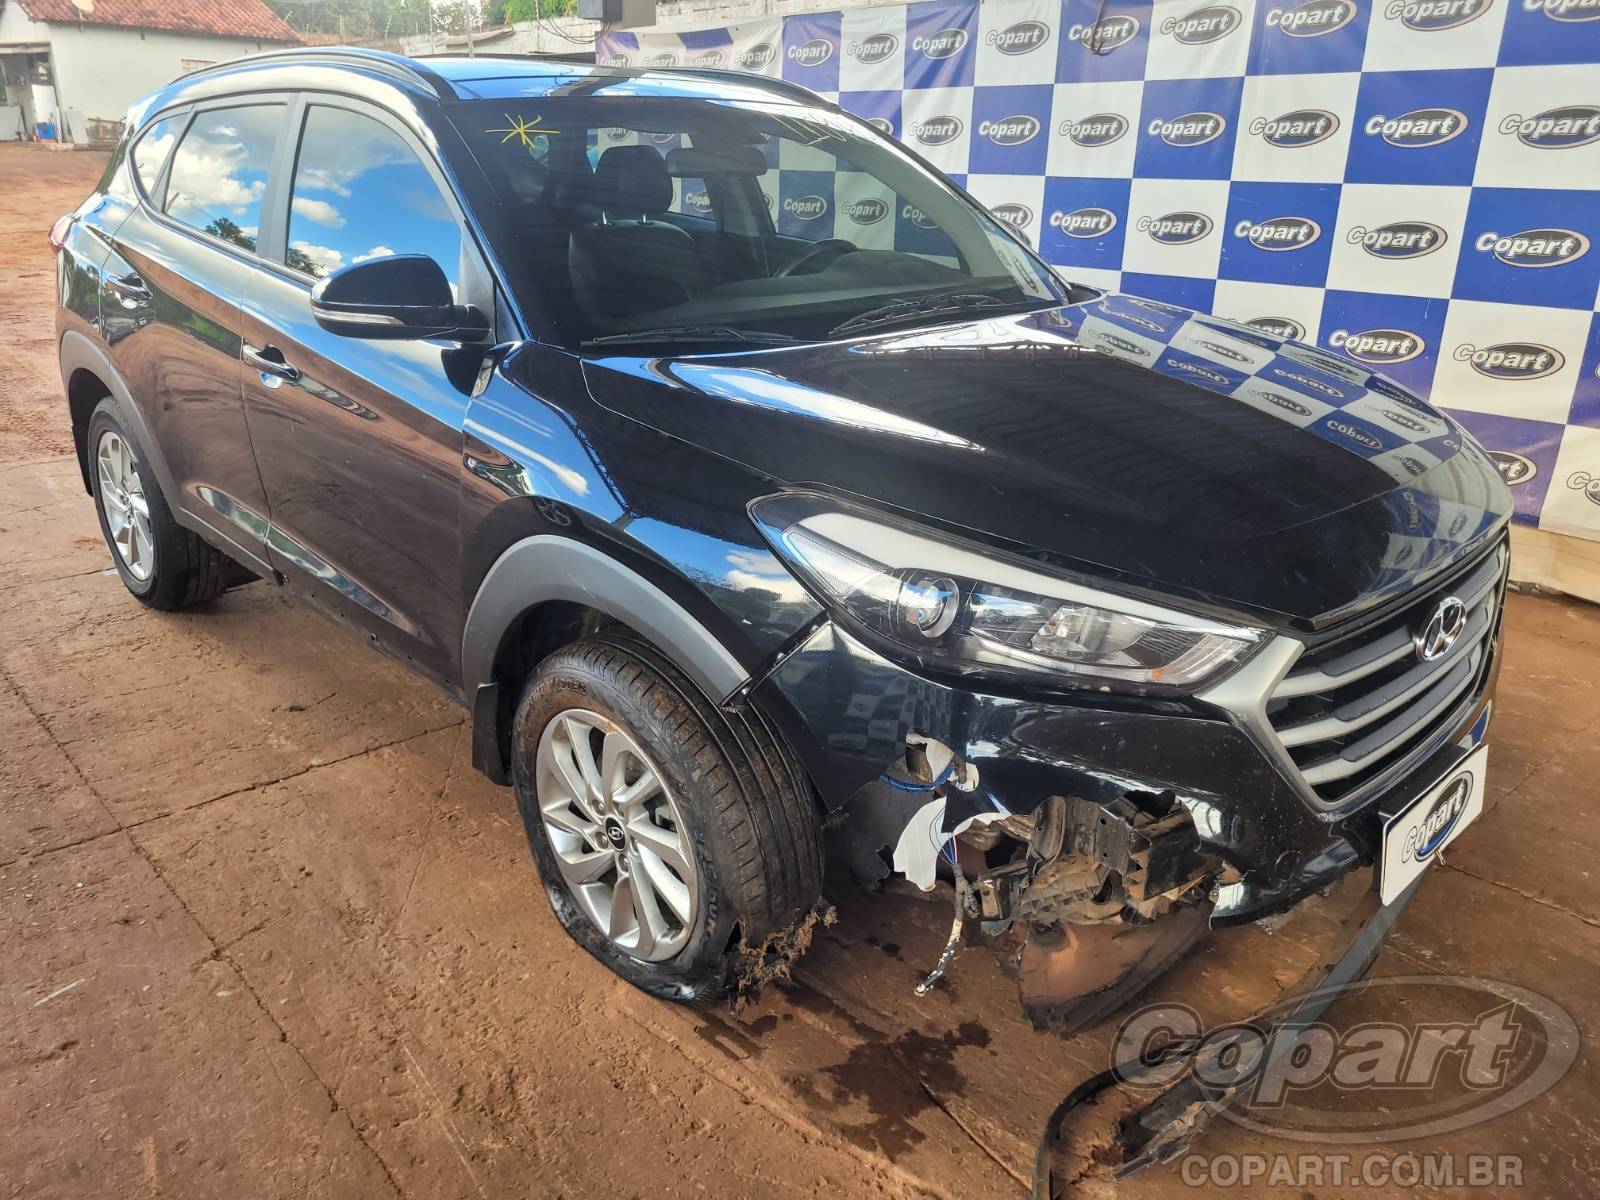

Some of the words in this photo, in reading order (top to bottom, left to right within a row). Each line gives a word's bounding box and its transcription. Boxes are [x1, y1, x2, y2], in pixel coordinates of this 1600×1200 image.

[1160, 11, 1231, 37] Copart
[1265, 3, 1344, 28] Copart
[848, 39, 890, 56] Copart
[913, 34, 961, 52] Copart
[986, 26, 1041, 47] Copart
[788, 44, 827, 61] Copart
[909, 120, 955, 138] Copart
[979, 120, 1033, 140] Copart
[1059, 119, 1120, 141] Copart
[1148, 119, 1216, 141] Copart
[1249, 116, 1327, 139] Copart
[1364, 113, 1457, 140] Copart
[784, 199, 822, 216] Copart
[842, 200, 882, 217] Copart
[1050, 210, 1108, 232] Copart
[1136, 215, 1201, 238] Copart
[1234, 219, 1311, 242] Copart
[1347, 226, 1433, 250] Copart
[1476, 232, 1577, 259] Copart
[1329, 329, 1414, 355] Copart
[1453, 344, 1553, 372] Copart
[1401, 781, 1466, 864] Copart
